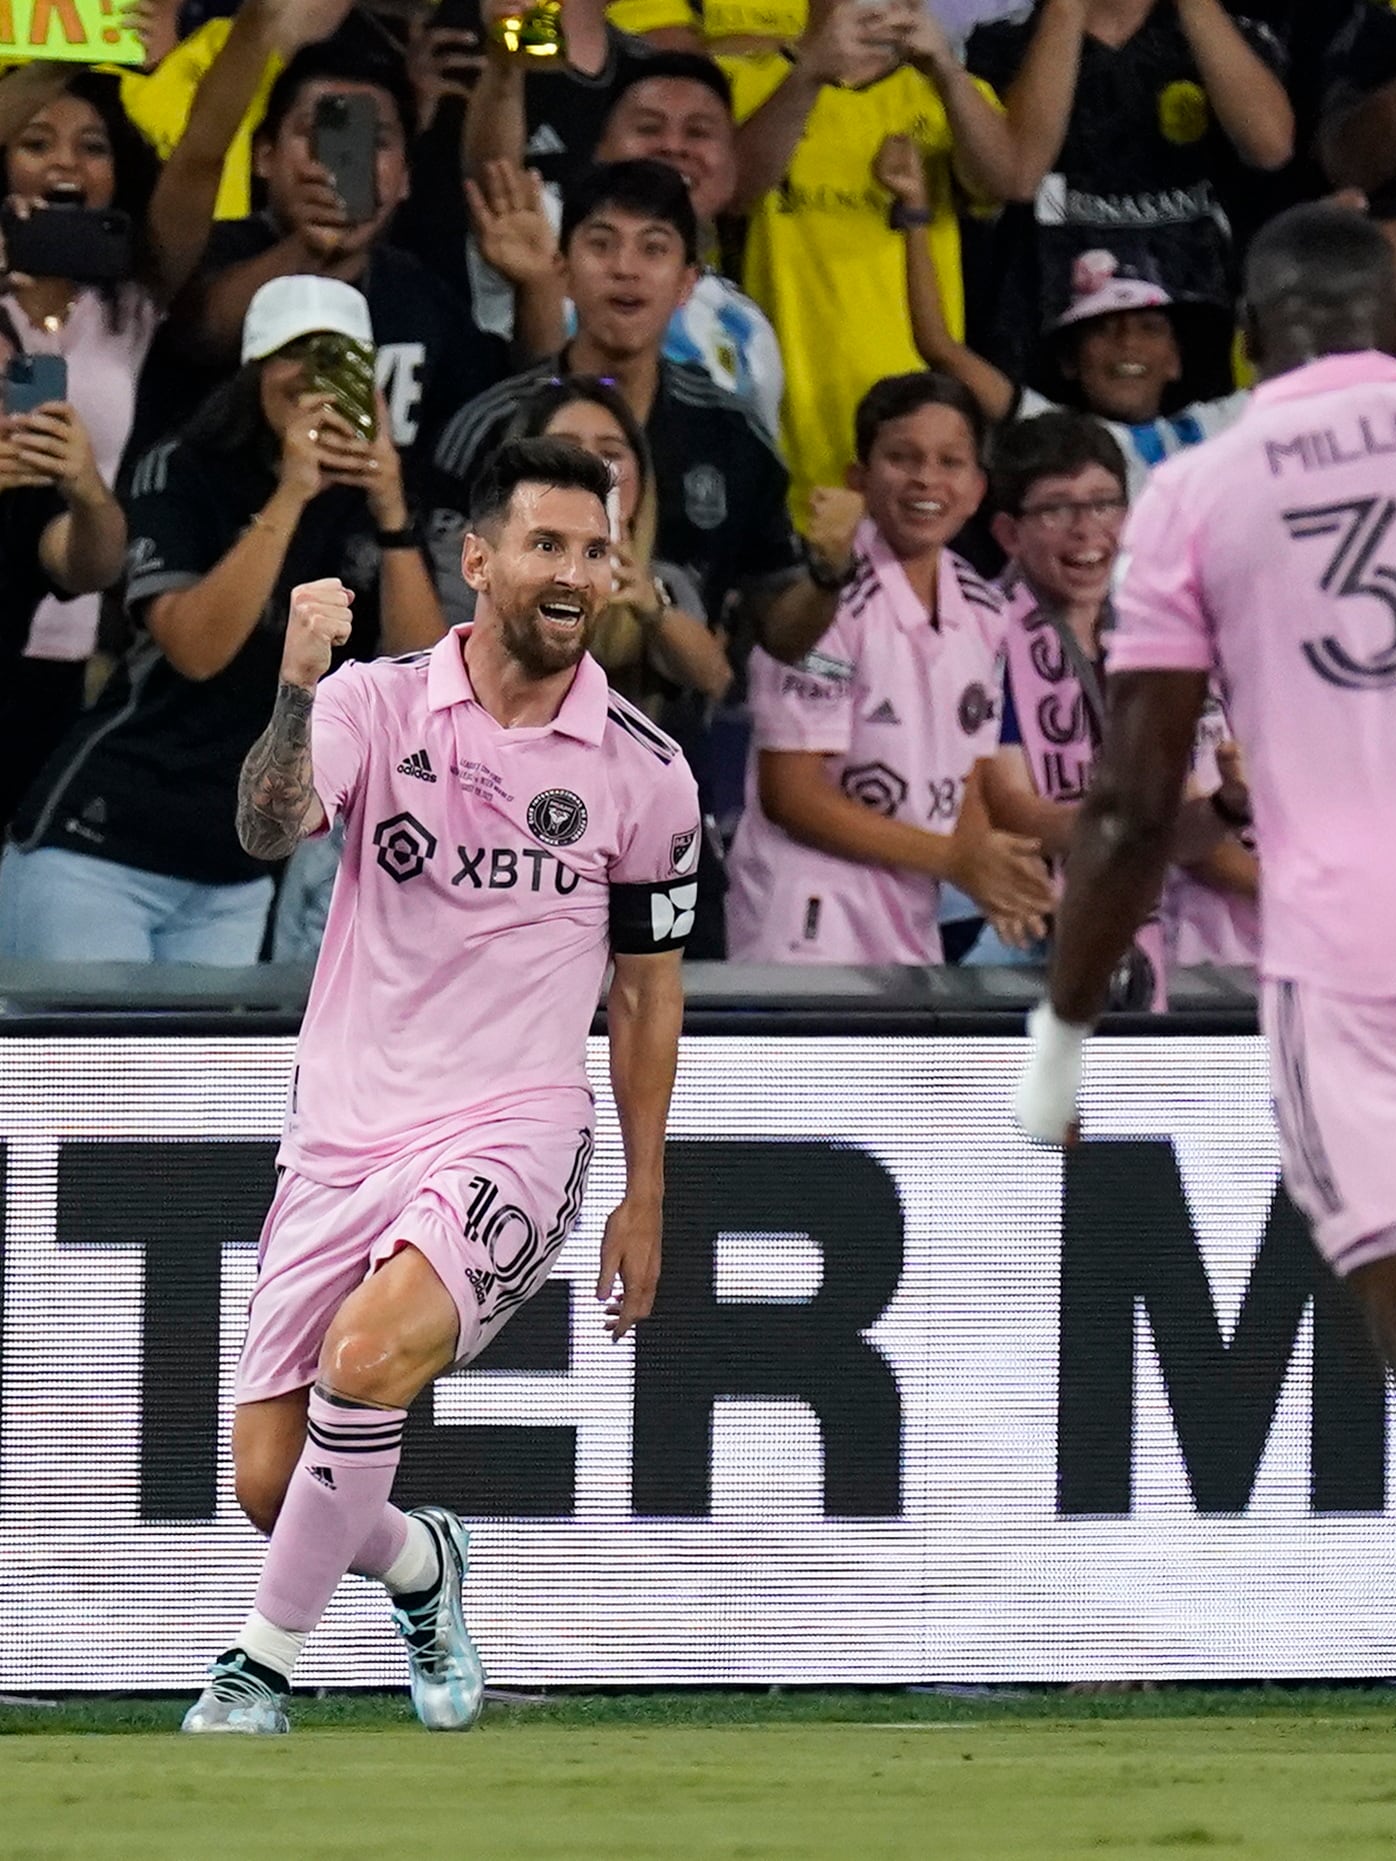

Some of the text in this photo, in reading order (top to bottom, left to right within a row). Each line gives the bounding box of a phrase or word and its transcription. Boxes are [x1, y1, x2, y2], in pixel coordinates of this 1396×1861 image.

[396, 764, 437, 783] adidas
[464, 1176, 538, 1282] 10
[464, 1267, 486, 1305] adidas
